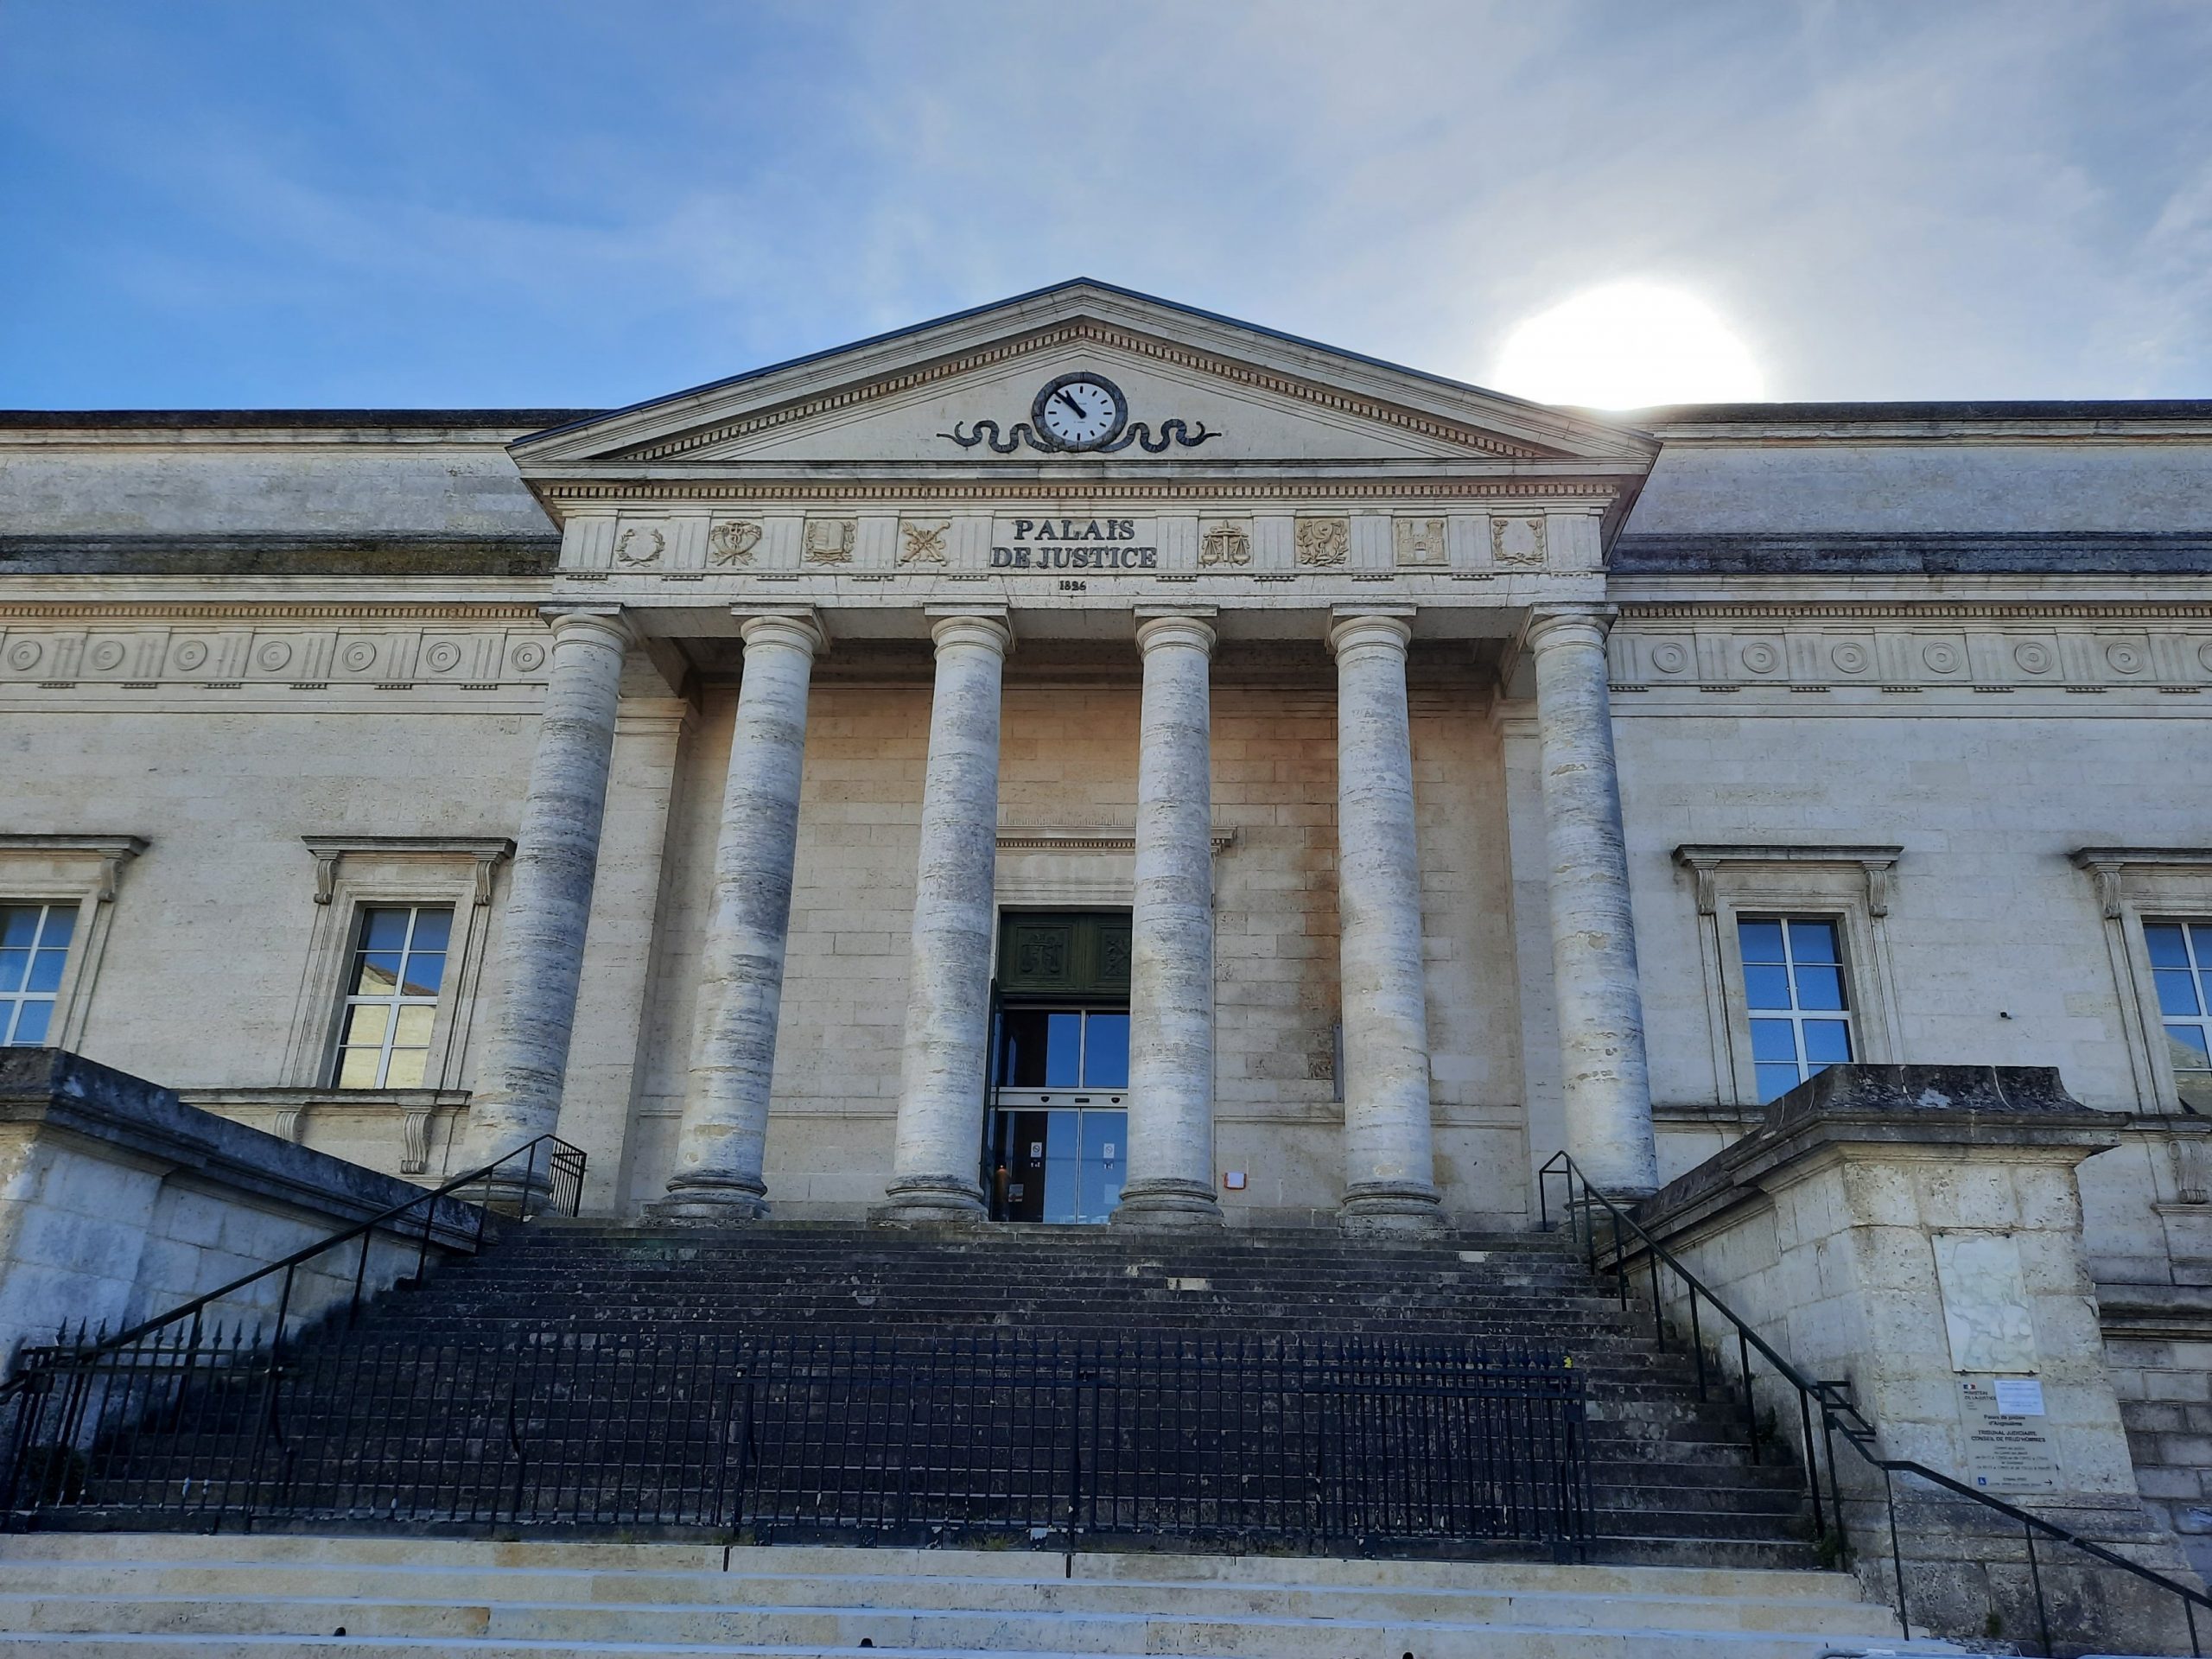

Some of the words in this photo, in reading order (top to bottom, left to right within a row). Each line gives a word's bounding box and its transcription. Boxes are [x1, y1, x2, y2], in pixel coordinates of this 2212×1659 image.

[1014, 519, 1135, 541] PALAIS
[991, 546, 1032, 569] DE
[1036, 546, 1157, 569] JUSTICE
[1059, 580, 1087, 591] 1826
